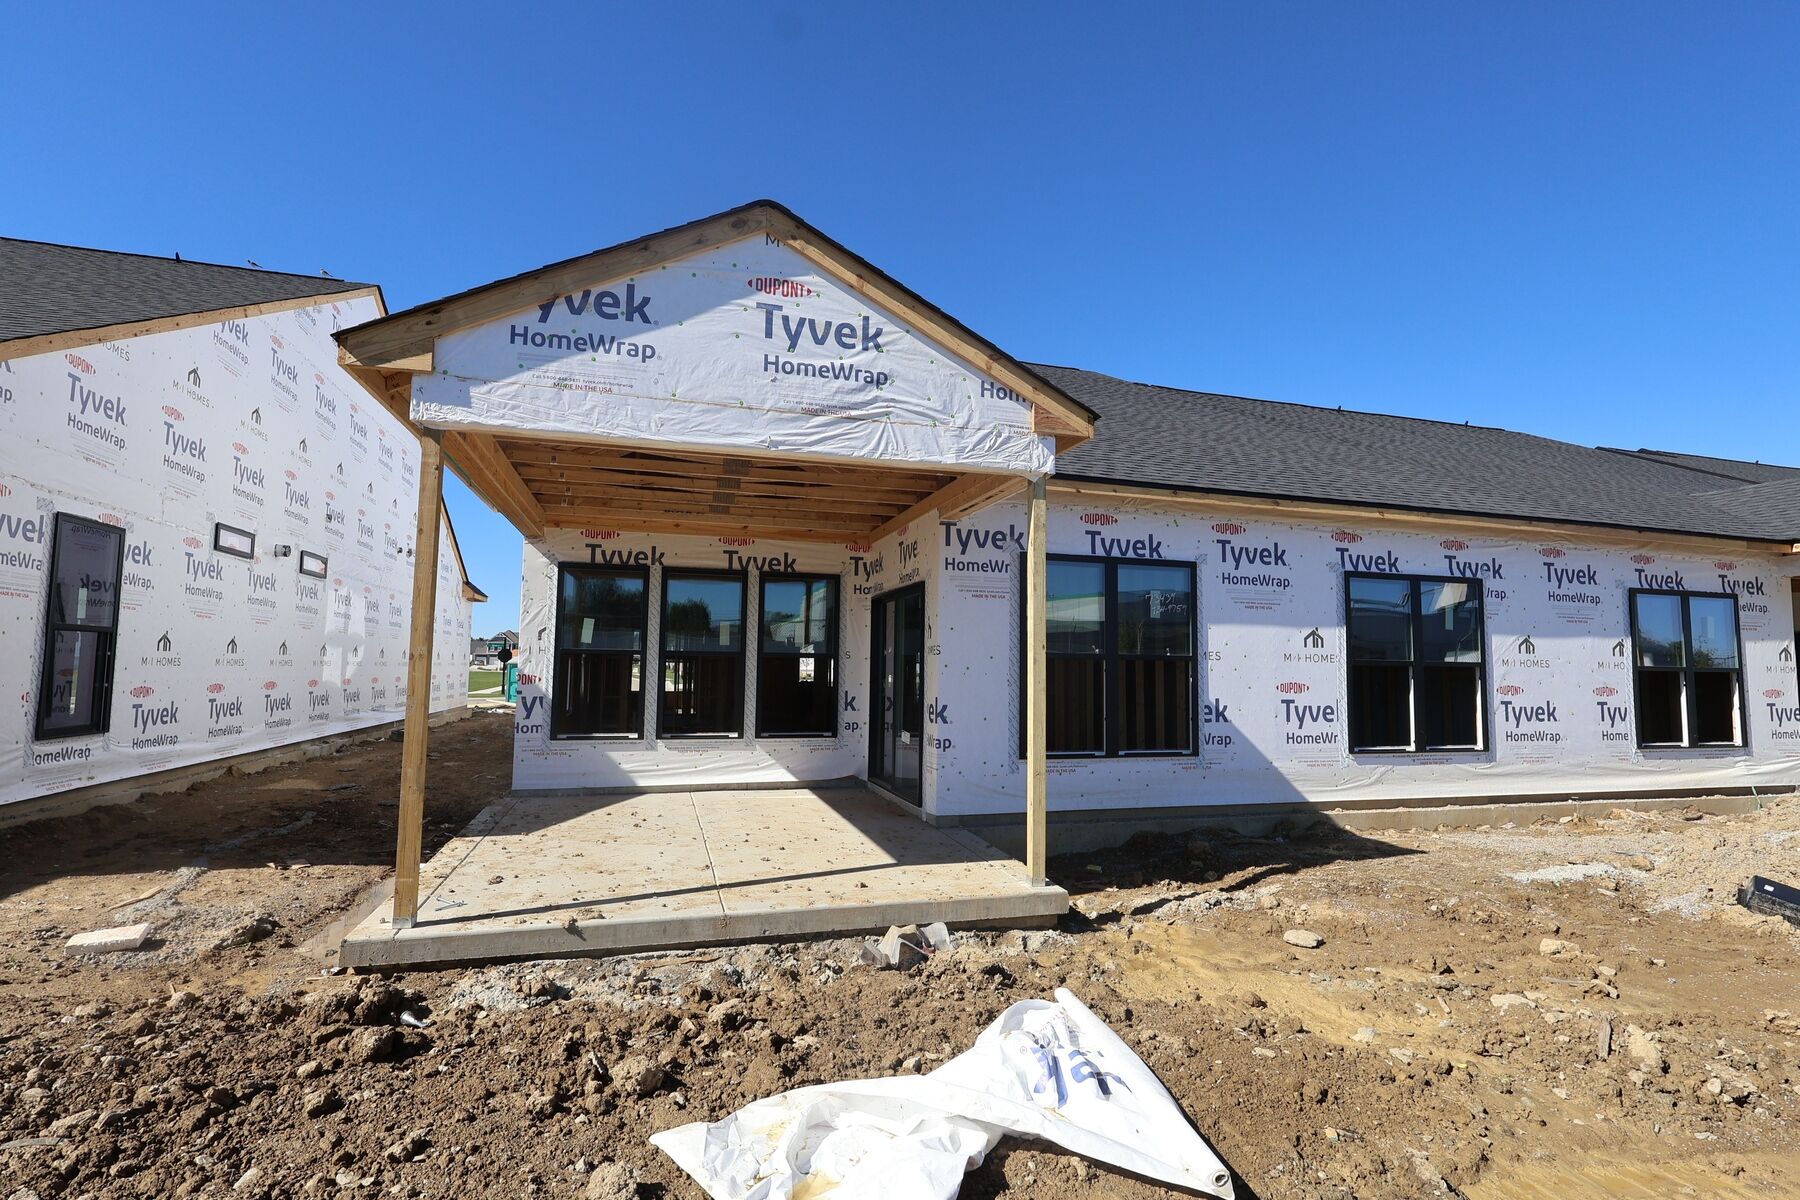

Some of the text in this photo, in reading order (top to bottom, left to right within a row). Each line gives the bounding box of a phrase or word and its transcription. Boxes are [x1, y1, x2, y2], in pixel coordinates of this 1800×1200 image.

[755, 278, 806, 298] DUPONT
[756, 302, 884, 353] Tyvek
[213, 330, 249, 366] HomeWrap
[510, 324, 656, 363] HomeWrap
[68, 353, 94, 375] DUPONT
[271, 347, 299, 386] Tyvek
[764, 354, 889, 389] HomeWrap
[67, 371, 127, 426] Tyvek
[186, 388, 210, 408] HOMES
[270, 374, 298, 402] HomeWrap
[553, 382, 575, 390] MADE
[599, 386, 613, 394] USA
[315, 384, 337, 417] Tyvek
[801, 407, 819, 415] MADE
[67, 412, 127, 451] HomeWrap
[350, 414, 368, 441] Tyvek
[163, 420, 207, 462] Tyvek
[163, 454, 206, 484] HomeWrap
[233, 455, 265, 489] Tyvek
[232, 484, 264, 508] HomeWrap
[285, 482, 310, 511] Tyvek
[358, 518, 374, 540] Tyvek
[1084, 514, 1114, 526] DUPONT
[1215, 523, 1242, 535] DUPONT
[585, 529, 616, 540] DUPONT
[722, 536, 752, 548] DUPONT
[939, 520, 1026, 556] Tyvek
[1085, 530, 1163, 559] Tyvek
[1335, 532, 1360, 543] DUPONT
[1443, 540, 1466, 551] DUPONT
[585, 542, 665, 566] Tyvek
[723, 549, 797, 573] Tyvek
[1217, 539, 1287, 570] Tyvek
[1336, 547, 1400, 573] Tyvek
[1542, 547, 1563, 558] DUPONT
[1634, 555, 1653, 565] DUPONT
[185, 551, 223, 582] Tyvek
[850, 552, 884, 582] Tyvek
[1444, 554, 1503, 580] Tyvek
[1544, 562, 1598, 589] Tyvek
[248, 567, 277, 594] Tyvek
[296, 580, 319, 602] Tyvek
[1221, 573, 1290, 590] HomeWrap
[1635, 568, 1685, 592] Tyvek
[1719, 574, 1765, 597] Tyvek
[185, 583, 223, 601] HomeWrap
[247, 594, 276, 609] HomeWrap
[334, 588, 352, 608] Tyvek
[1548, 590, 1601, 607] HomeWrap
[156, 657, 181, 667] HOMES
[1305, 653, 1337, 663] HOME
[1520, 659, 1550, 668] HOMES
[133, 686, 152, 699] DUPONT
[343, 688, 360, 708] Tyvek
[371, 687, 386, 705] Tyvek
[1280, 682, 1306, 693] DUPONT
[1499, 685, 1521, 696] DUPONT
[1596, 686, 1616, 697] DUPONT
[1764, 688, 1782, 699] DUPONT
[208, 696, 243, 725] Tyvek
[265, 693, 292, 717] Tyvek
[308, 690, 330, 712] Tyvek
[132, 700, 178, 735] Tyvek
[264, 718, 292, 730] HomeWrap
[1501, 700, 1557, 729] Tyvek
[132, 734, 179, 750] HomeWrap
[208, 725, 243, 739] HomeWrap
[1506, 730, 1561, 743] HomeWrap
